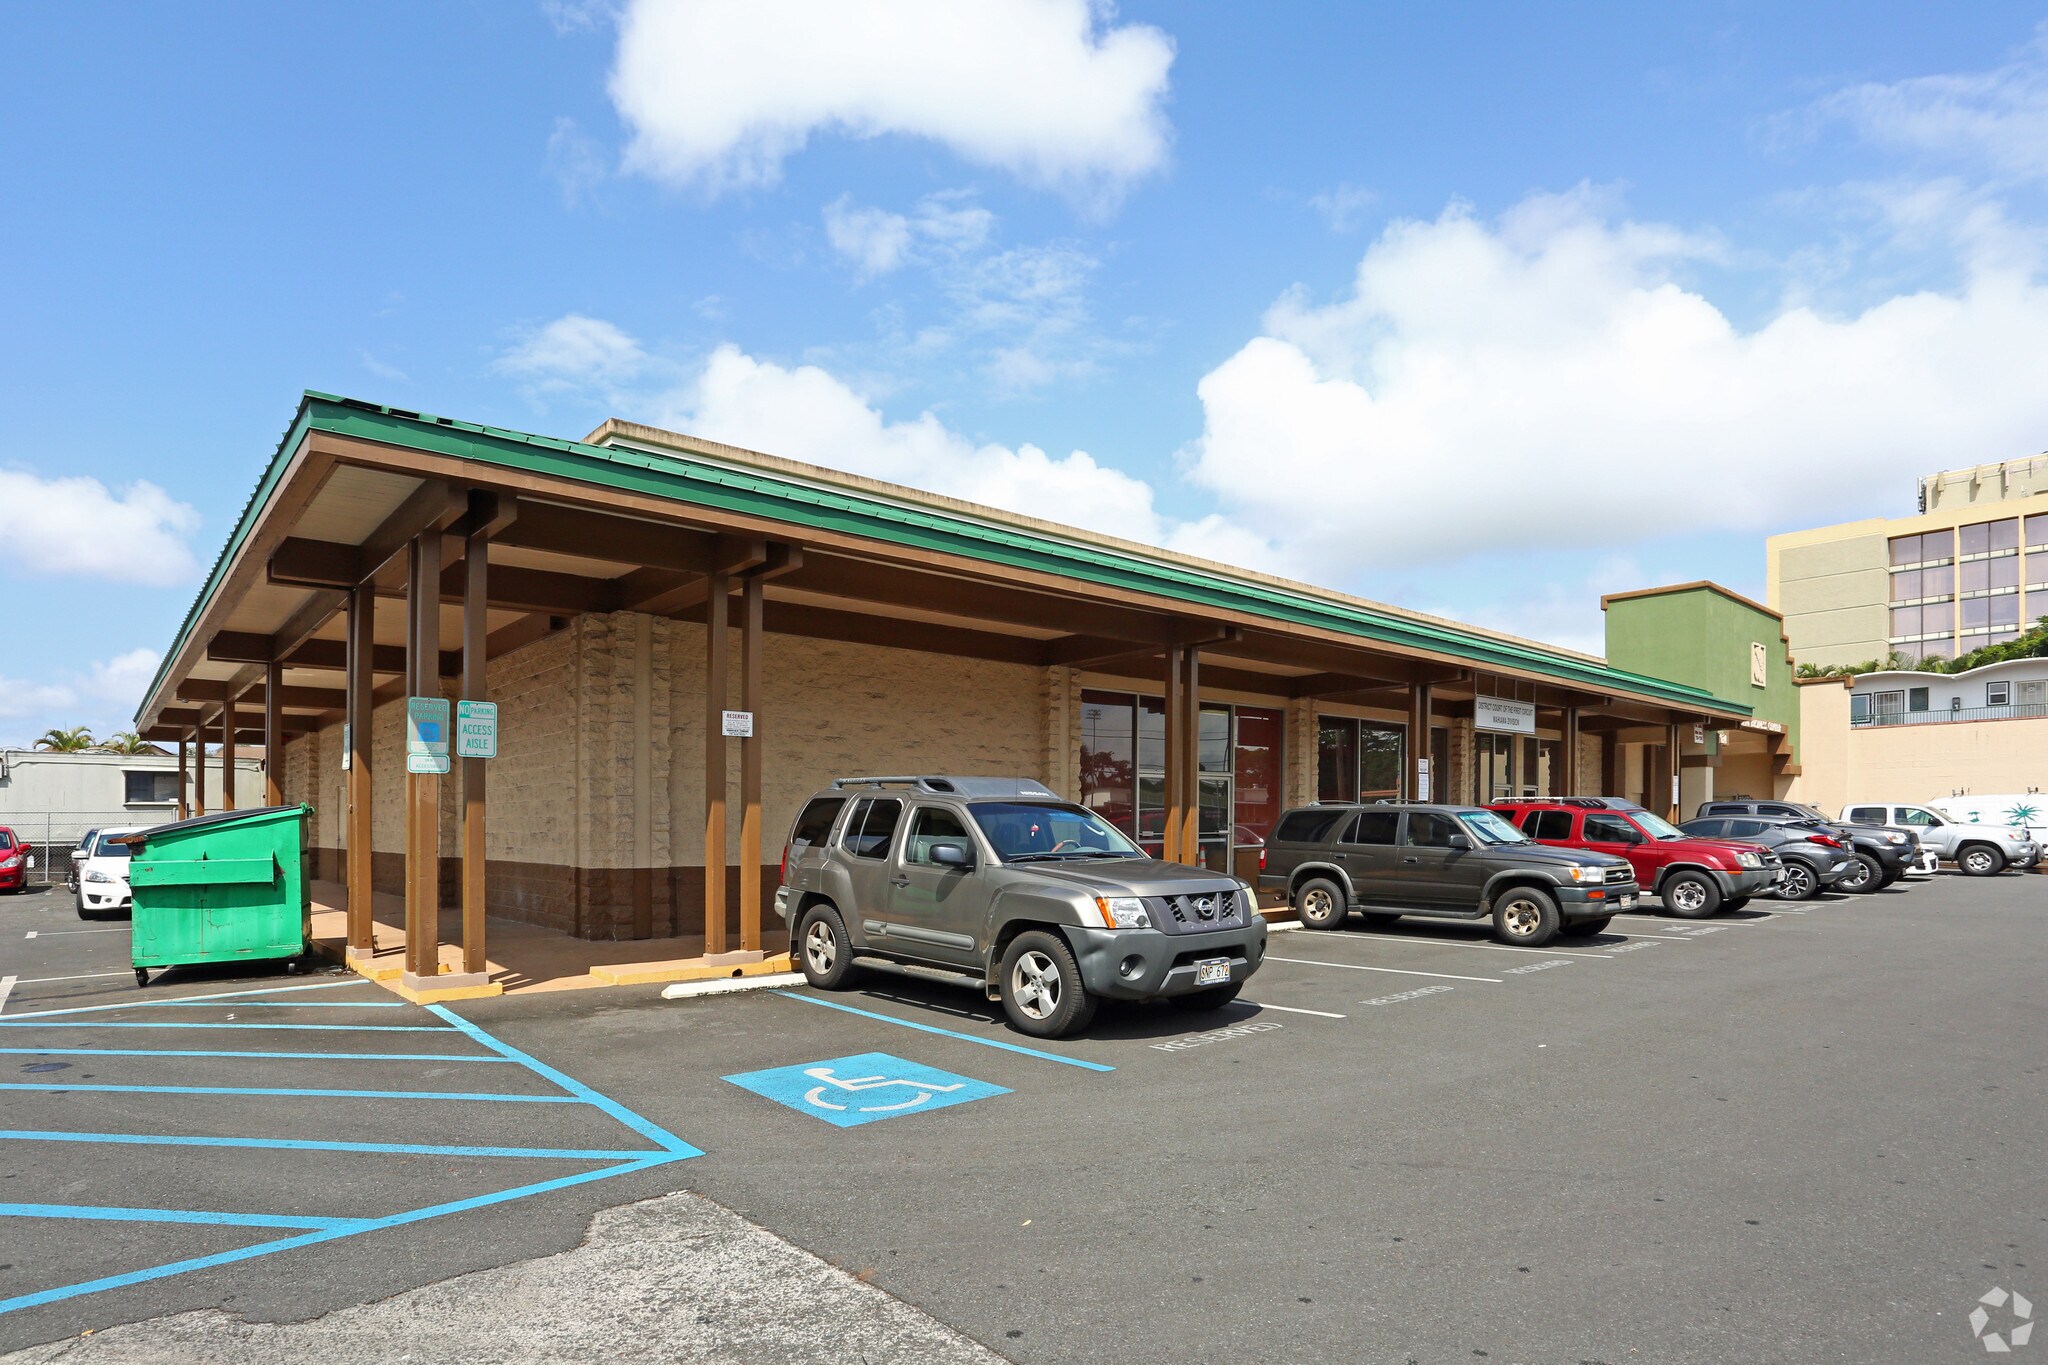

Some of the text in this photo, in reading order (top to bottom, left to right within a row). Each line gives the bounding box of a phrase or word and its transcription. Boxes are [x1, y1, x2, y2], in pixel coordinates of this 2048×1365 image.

[411, 702, 447, 712] RESERVED
[460, 704, 493, 715] NO PARKING
[462, 724, 492, 735] ACCESS
[466, 738, 488, 749] AISLE
[1148, 1022, 1283, 1052] RESERVED
